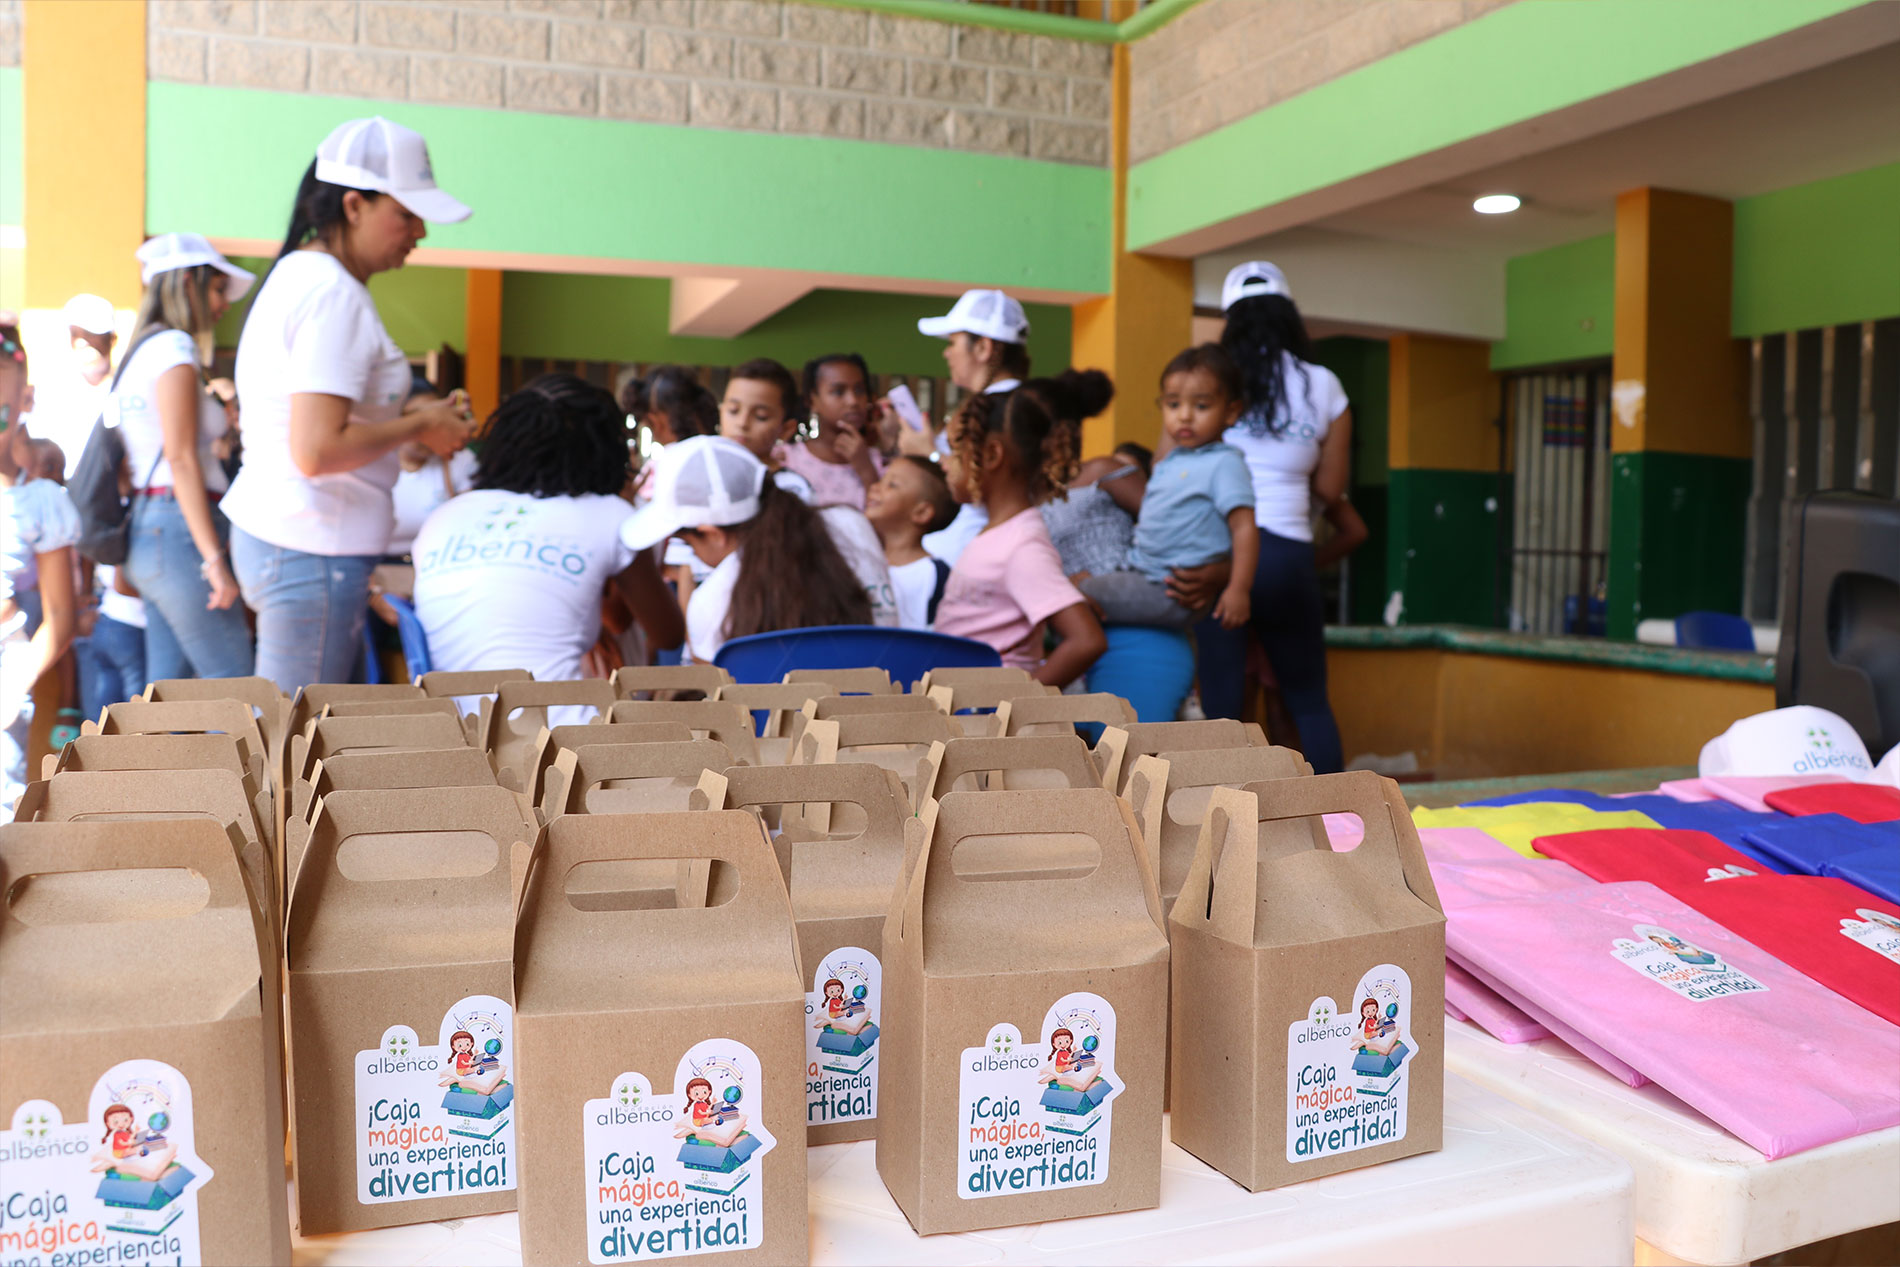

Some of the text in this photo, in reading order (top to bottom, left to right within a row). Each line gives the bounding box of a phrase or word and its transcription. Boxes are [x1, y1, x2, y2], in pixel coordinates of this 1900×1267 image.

[421, 534, 586, 576] albenco
[1297, 1025, 1351, 1044] albenco
[367, 1058, 439, 1075] albenco
[972, 1055, 1039, 1072] albenco
[1296, 1063, 1336, 1092] ¡Caja
[806, 1073, 871, 1094] periencia
[1296, 1085, 1357, 1111] mágica,
[368, 1098, 421, 1128] ¡Caja
[597, 1107, 674, 1126] albenco
[808, 1089, 872, 1121] rtida!
[970, 1096, 1020, 1125] ¡Caja
[1295, 1095, 1398, 1128] una experiencia
[368, 1122, 449, 1150] mágica,
[970, 1119, 1045, 1146] mágica,
[1295, 1111, 1398, 1157] divertida!
[0, 1138, 89, 1161] albenco
[368, 1139, 506, 1167] una experiencia
[969, 1134, 1097, 1162] una experiencia
[369, 1157, 507, 1198] divertida!
[599, 1151, 654, 1183] ¡Caja
[968, 1152, 1096, 1193] divertida!
[599, 1177, 685, 1207] mágica,
[0, 1190, 68, 1229] ¡Caja
[599, 1194, 747, 1224] una experiencia
[0, 1219, 106, 1253] mágica,
[600, 1213, 747, 1257] divertida!
[51, 1234, 182, 1267] experiencia
